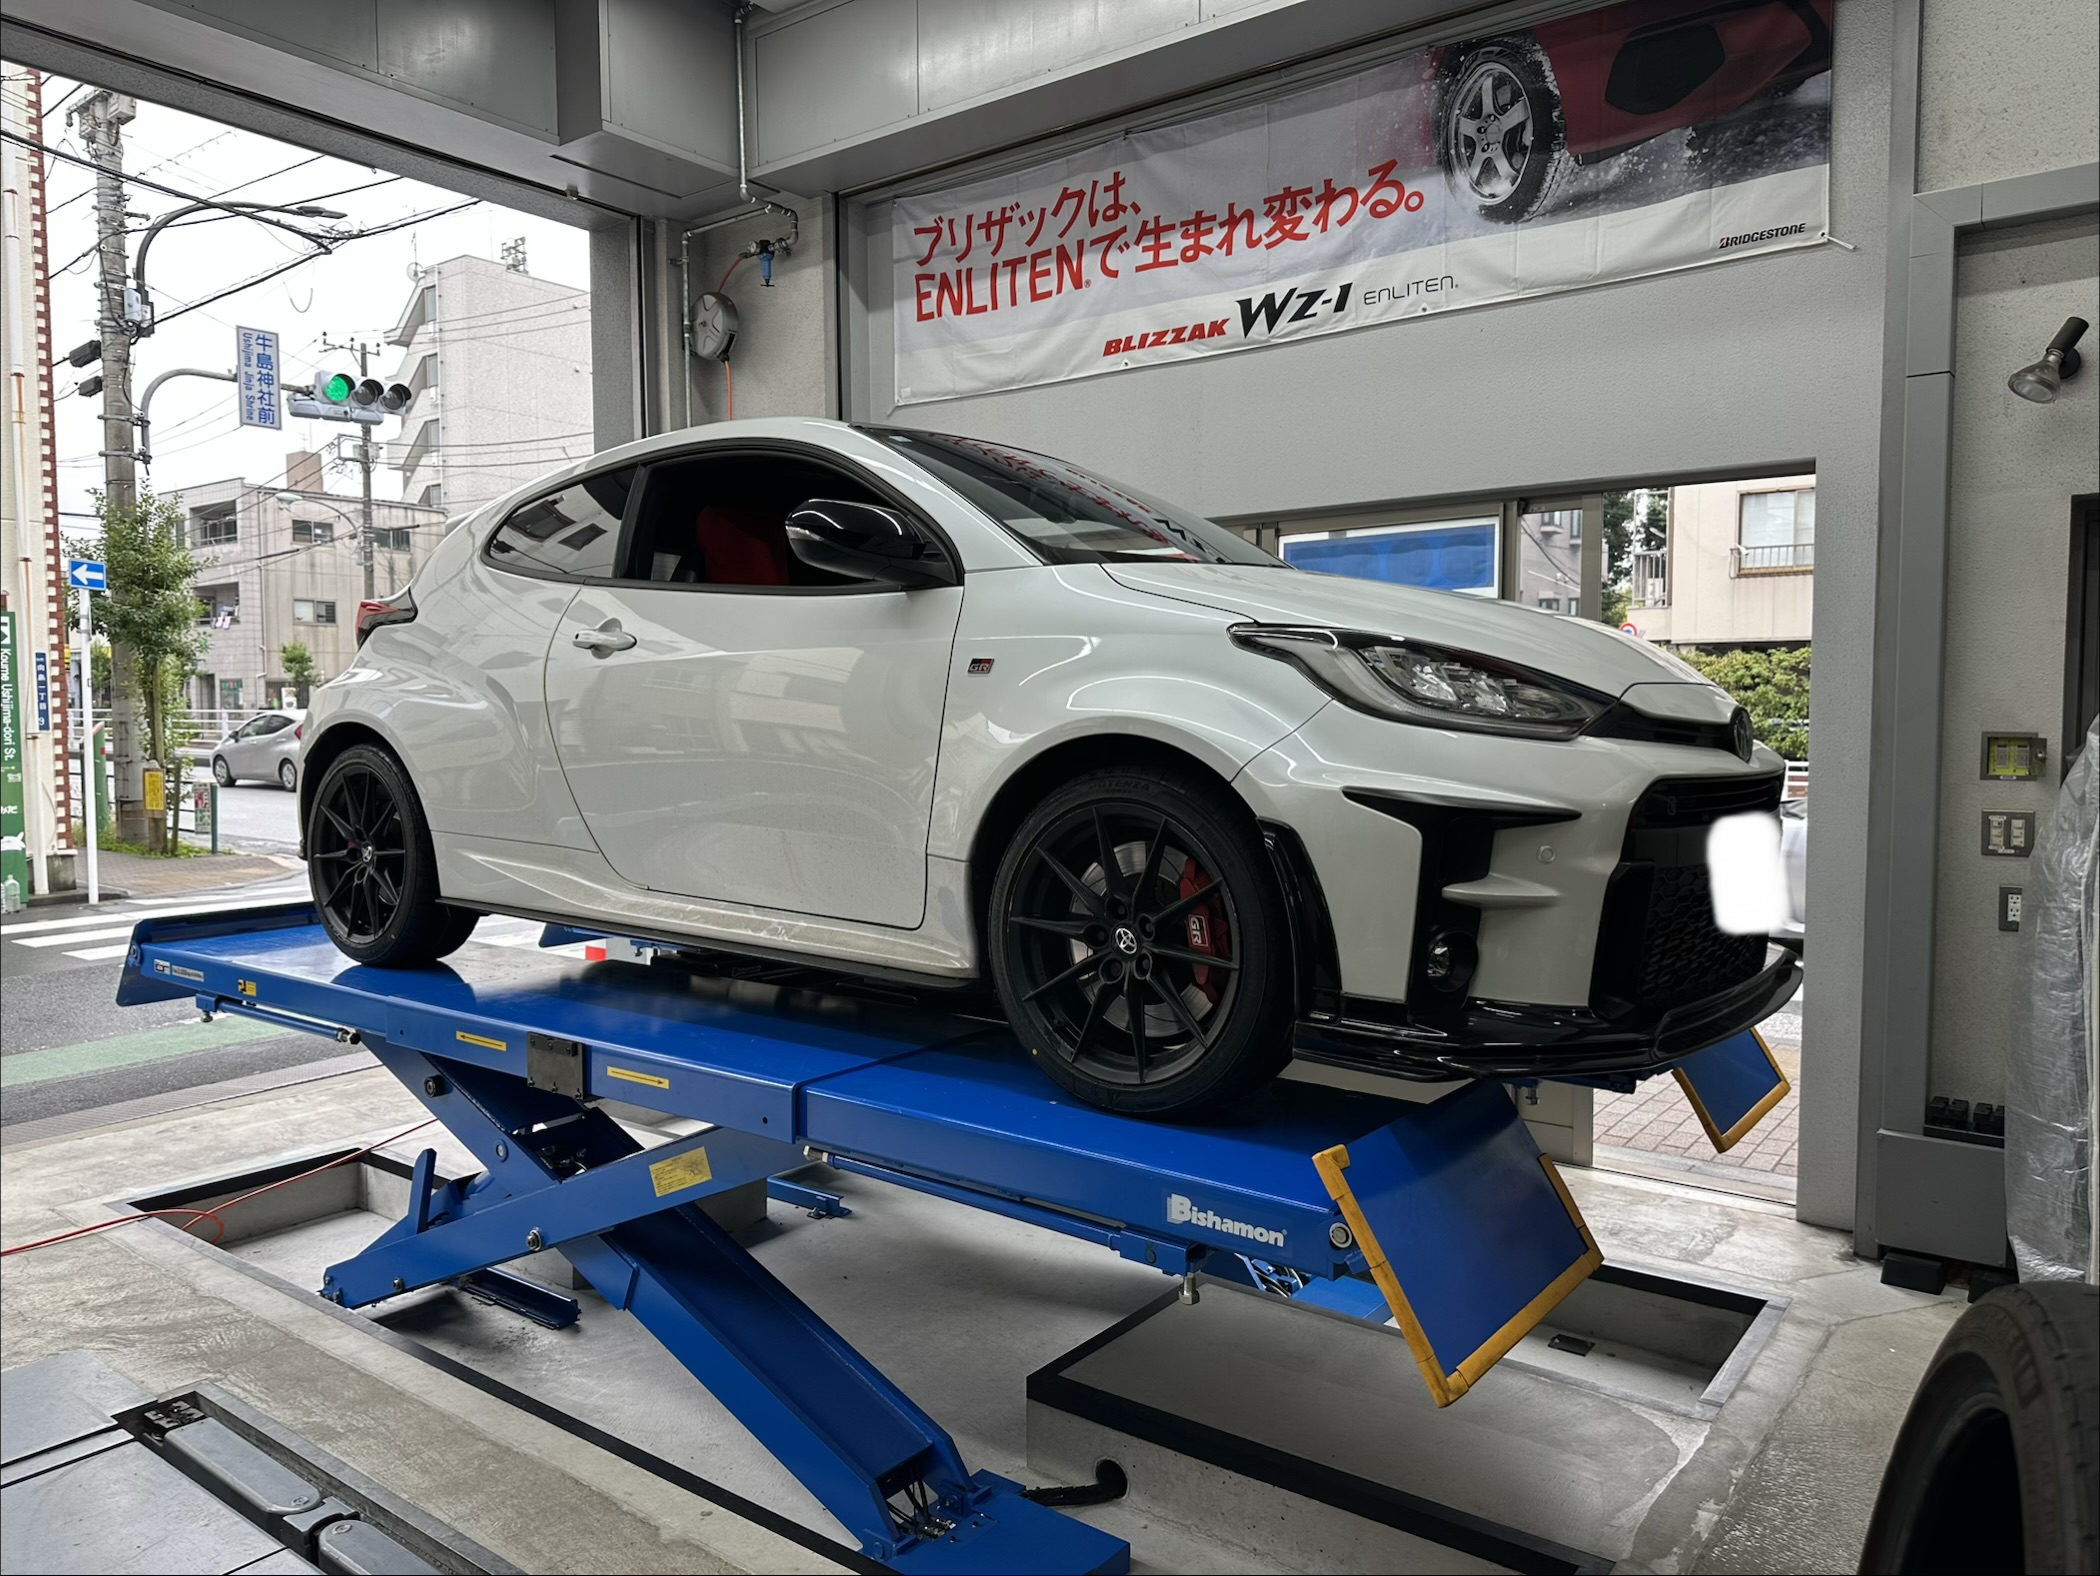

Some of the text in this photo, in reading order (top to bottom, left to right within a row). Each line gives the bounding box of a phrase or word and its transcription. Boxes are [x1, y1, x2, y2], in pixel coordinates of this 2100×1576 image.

[914, 171, 1142, 267] ブリザックは、
[1718, 222, 1806, 249] BRIDGESTONE
[1102, 318, 1231, 358] BLIZZAK
[242, 332, 256, 421] Ushijima Jinja Shrine
[255, 333, 276, 425] 牛島神社前
[1, 648, 12, 682] Koume
[969, 662, 990, 673] GR
[1, 683, 16, 746] Ushijima-dori
[38, 717, 45, 726] 9
[4, 747, 16, 762] St.
[1190, 917, 1202, 944] GR
[1167, 1193, 1285, 1247] Bishamon
